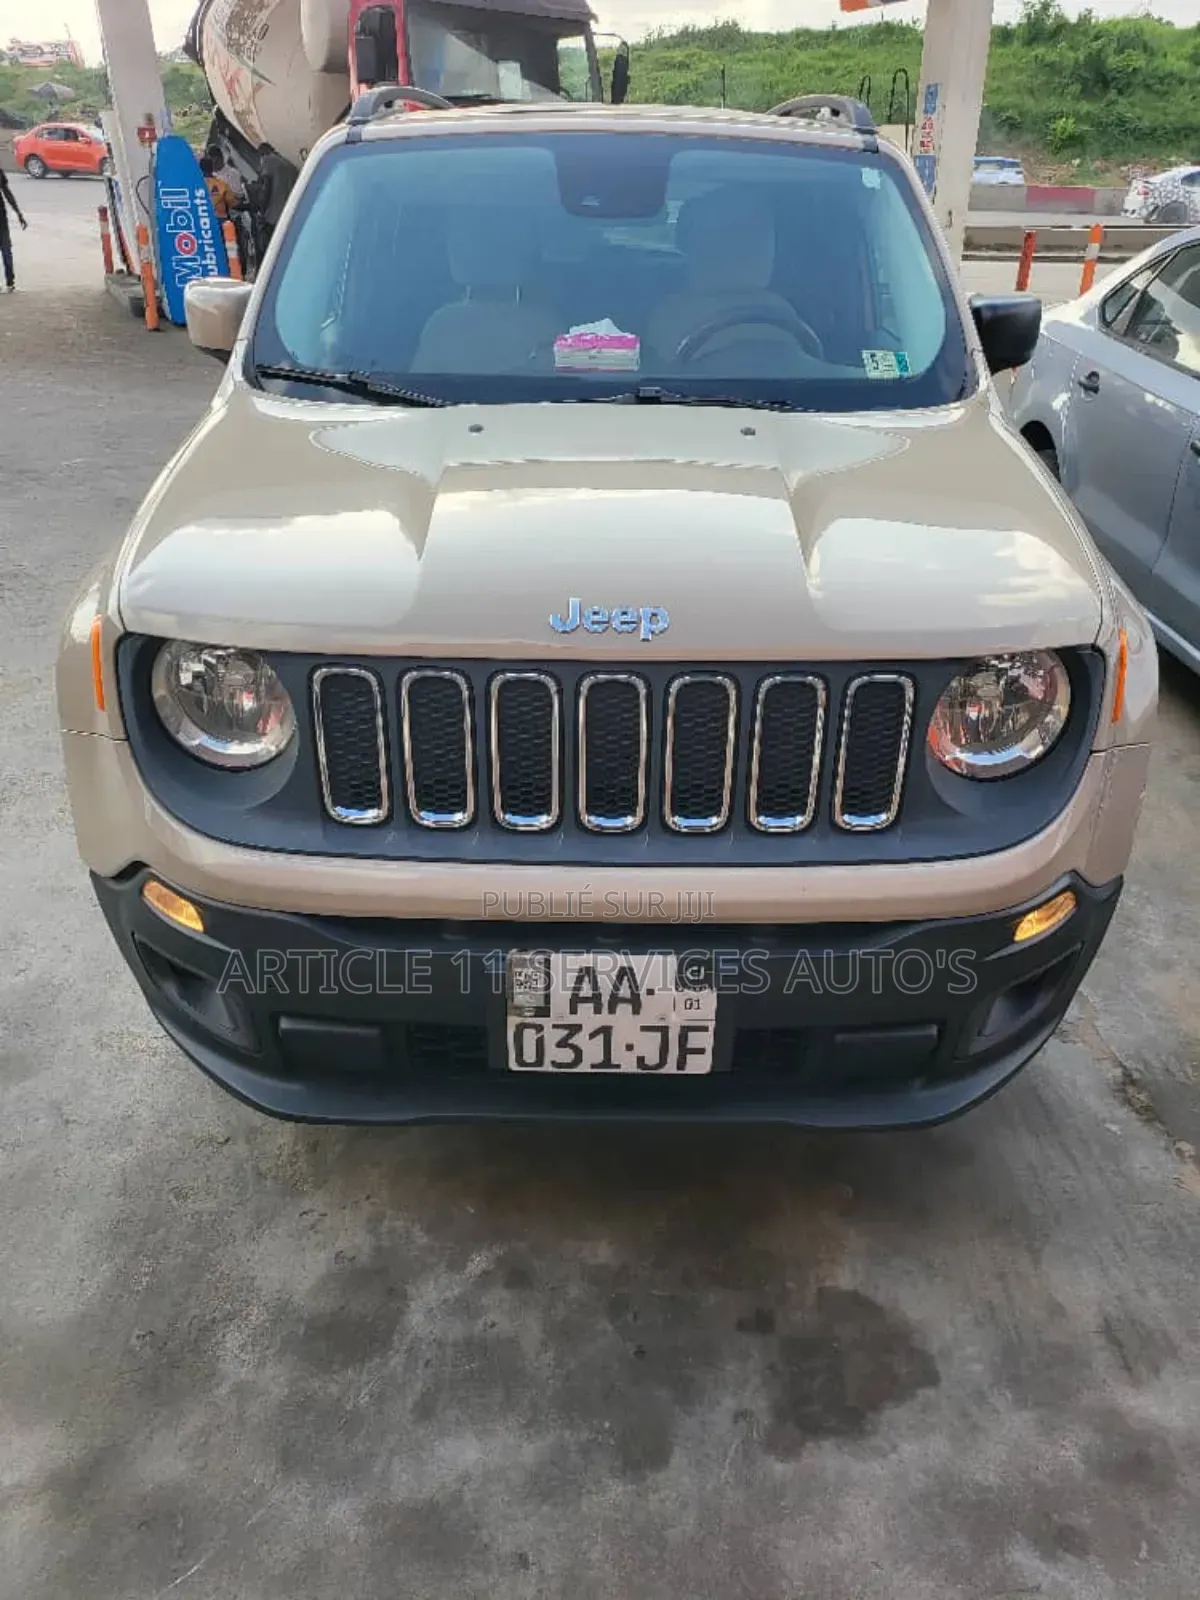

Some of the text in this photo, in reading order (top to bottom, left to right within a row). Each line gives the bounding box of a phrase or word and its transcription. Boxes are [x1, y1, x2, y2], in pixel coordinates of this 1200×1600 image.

[159, 188, 202, 287] Mobil
[194, 188, 219, 277] ubricants
[549, 596, 670, 641] Jeep
